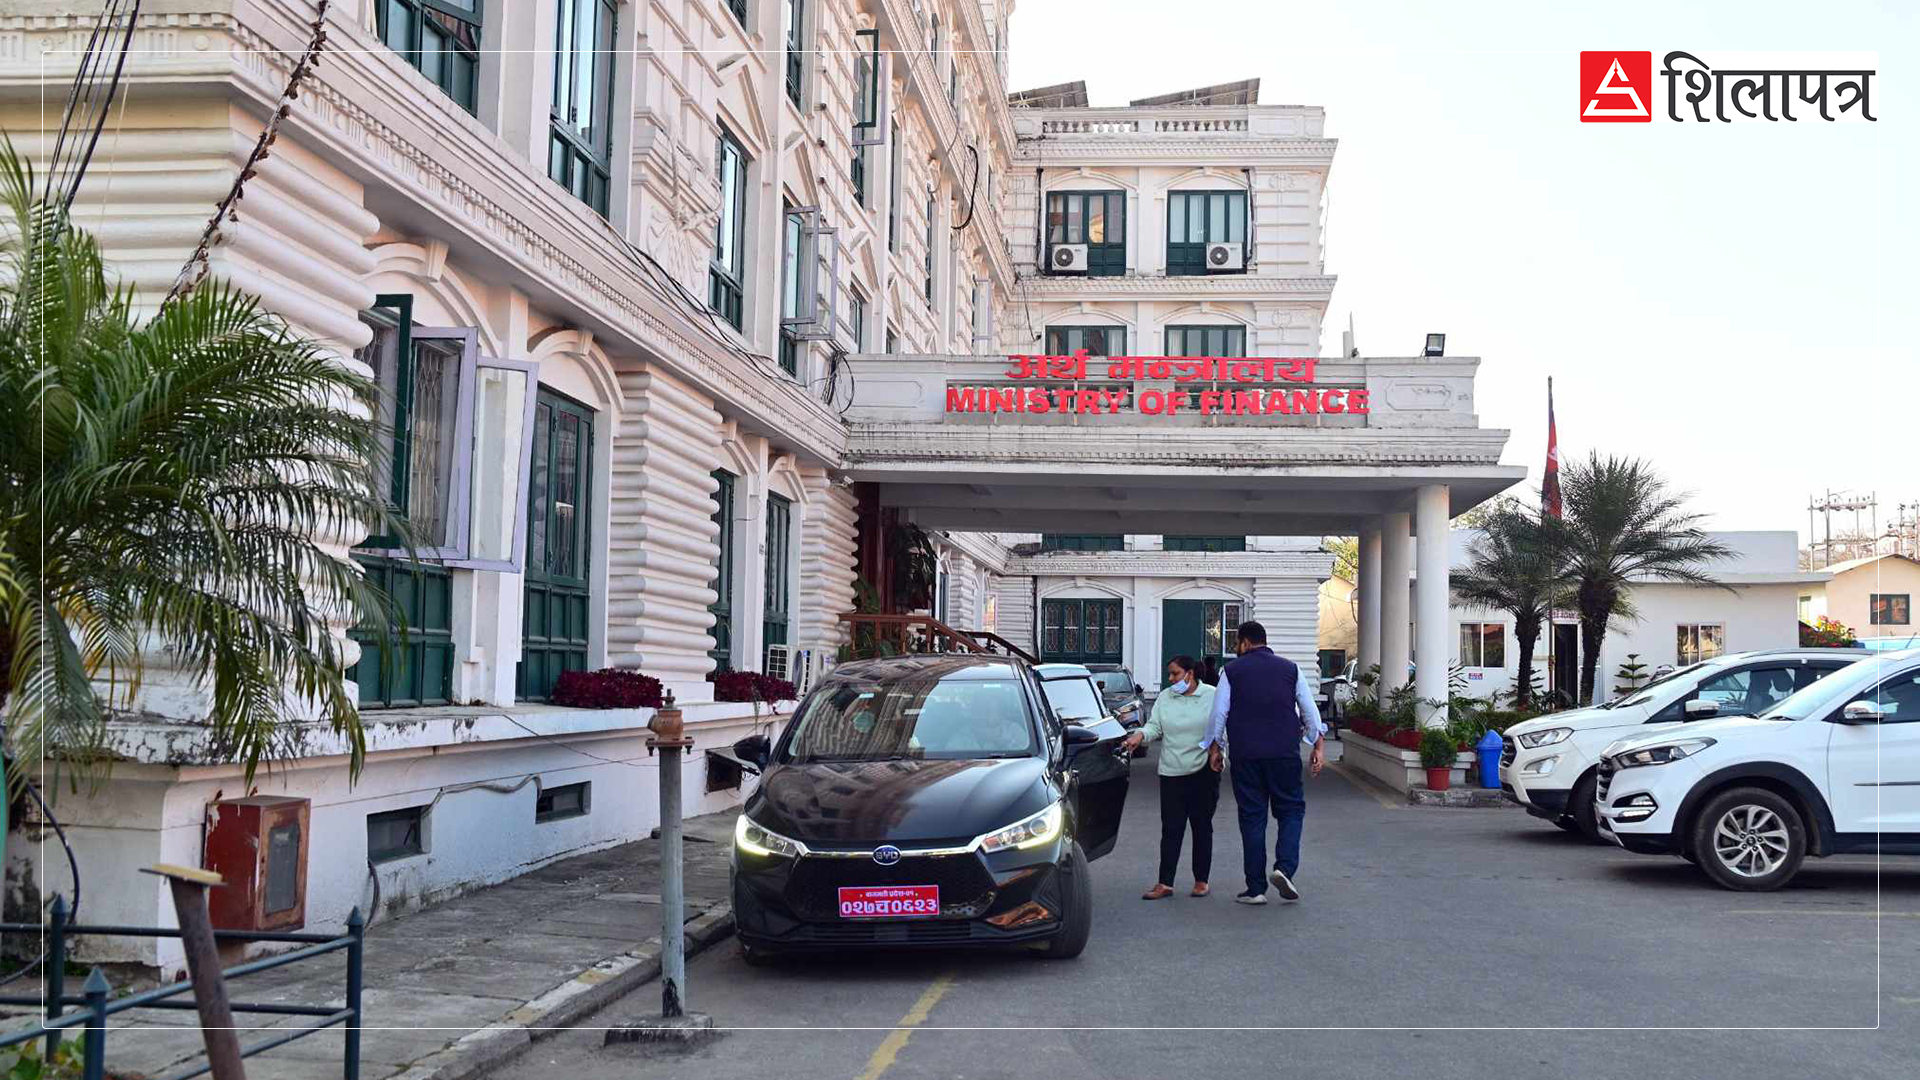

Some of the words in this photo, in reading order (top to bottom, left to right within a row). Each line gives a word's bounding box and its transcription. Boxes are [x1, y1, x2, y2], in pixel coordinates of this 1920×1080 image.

[1004, 349, 1090, 379] अर्थ
[1107, 356, 1319, 384] मन्त्रालय
[946, 386, 1129, 415] MINISTRY
[1138, 388, 1188, 416] OF
[1200, 389, 1370, 416] FINANCE
[875, 851, 899, 860] BYD
